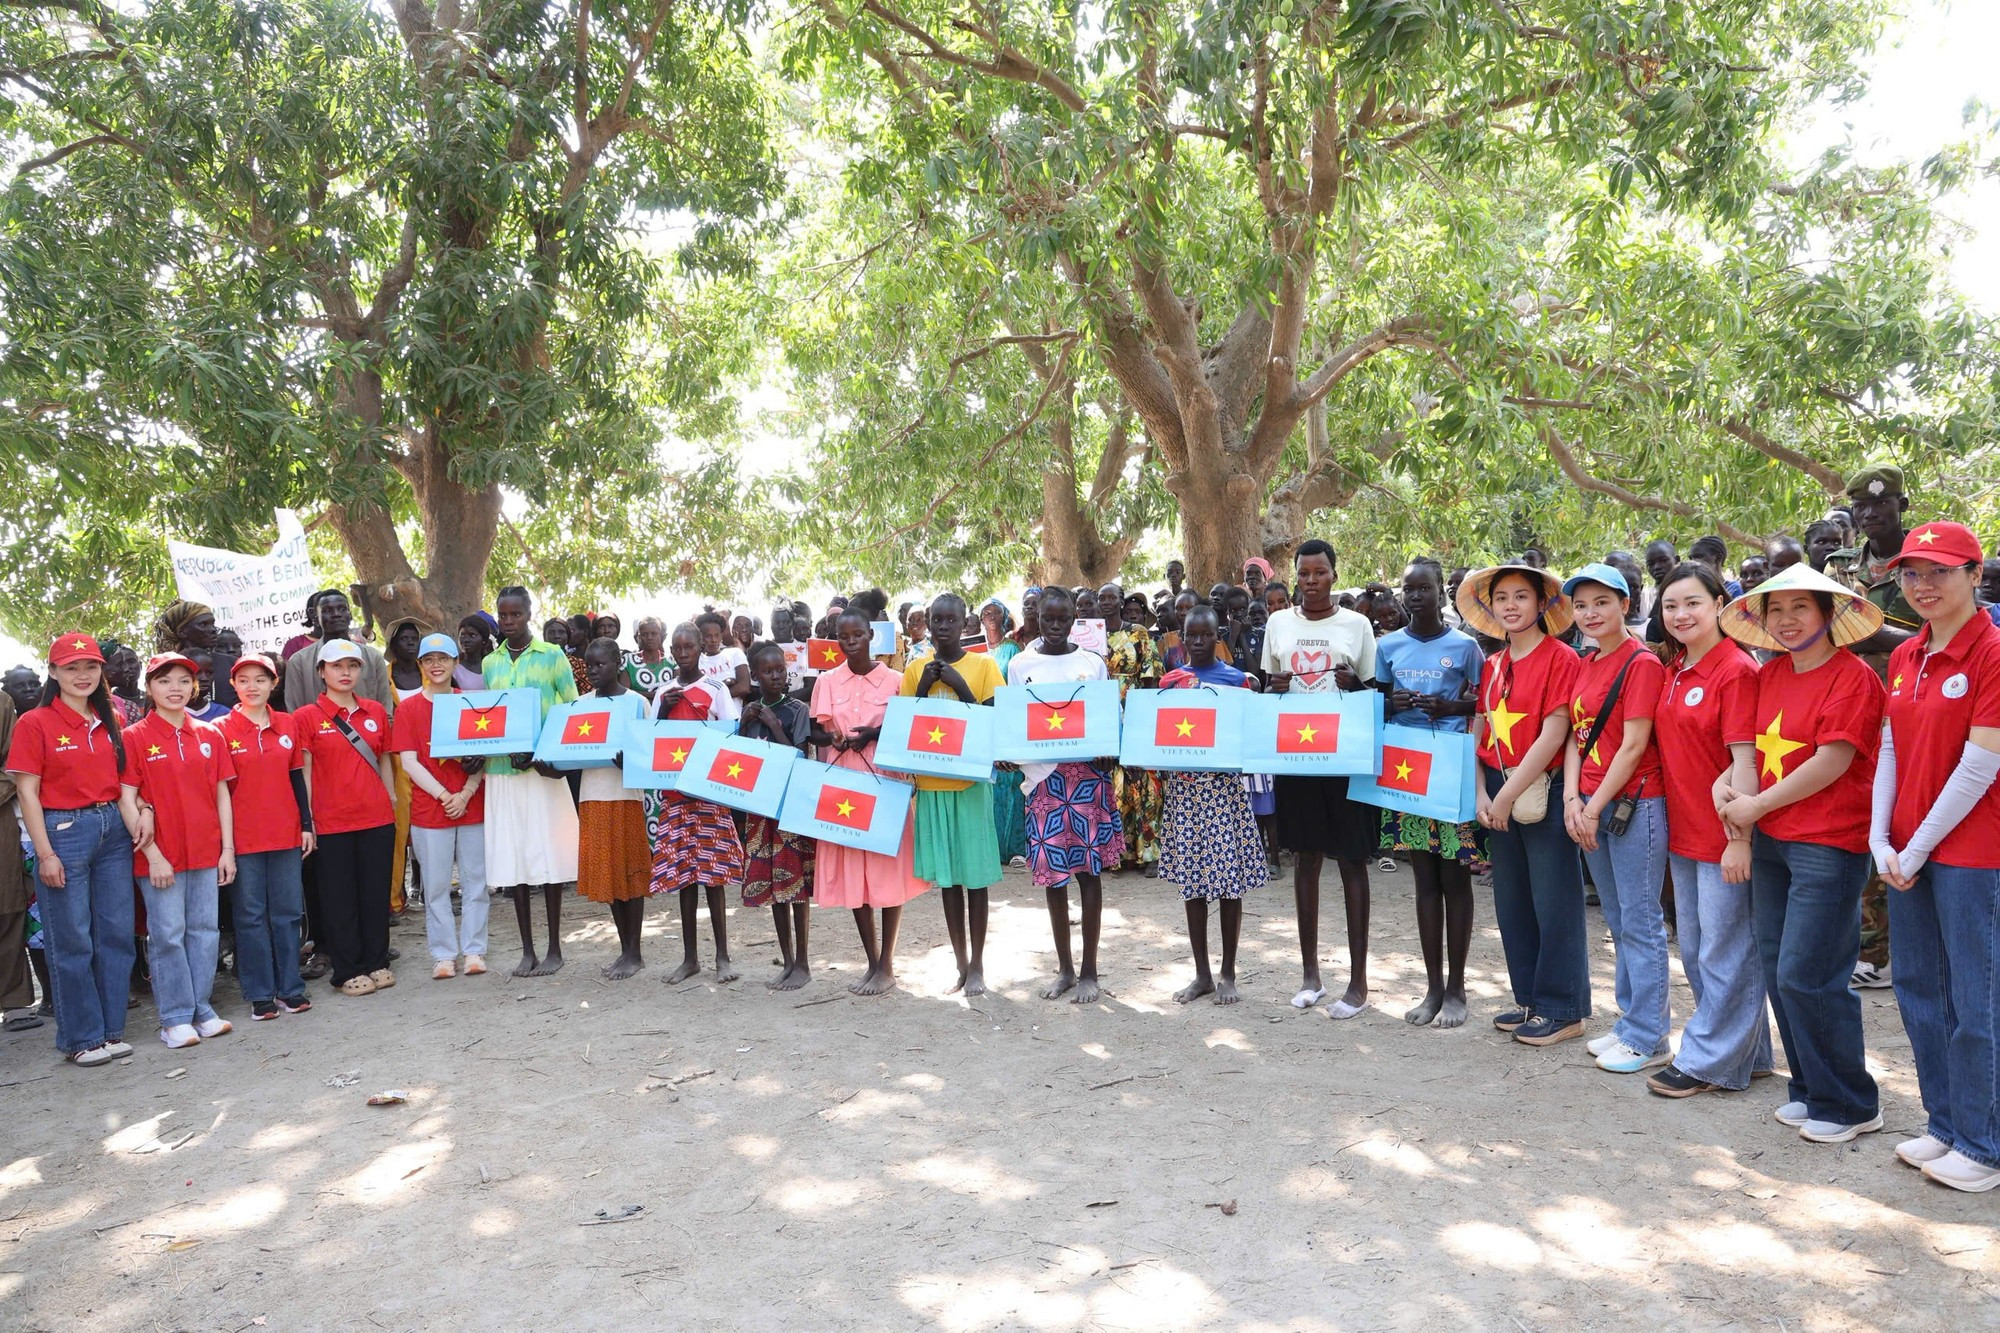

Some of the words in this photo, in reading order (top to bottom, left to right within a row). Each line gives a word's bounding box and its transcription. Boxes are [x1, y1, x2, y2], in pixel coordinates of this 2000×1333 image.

[255, 615, 279, 631] THE
[250, 639, 268, 651] TOP
[1296, 639, 1330, 647] FOREVER
[1394, 669, 1443, 679] ETIHAD
[934, 755, 954, 763] NAM
[710, 783, 727, 792] VIET
[729, 789, 745, 798] NAM
[1382, 789, 1399, 798] VIET
[1401, 793, 1420, 802] NAM
[820, 823, 840, 832] VIET
[842, 828, 861, 837] NAM
